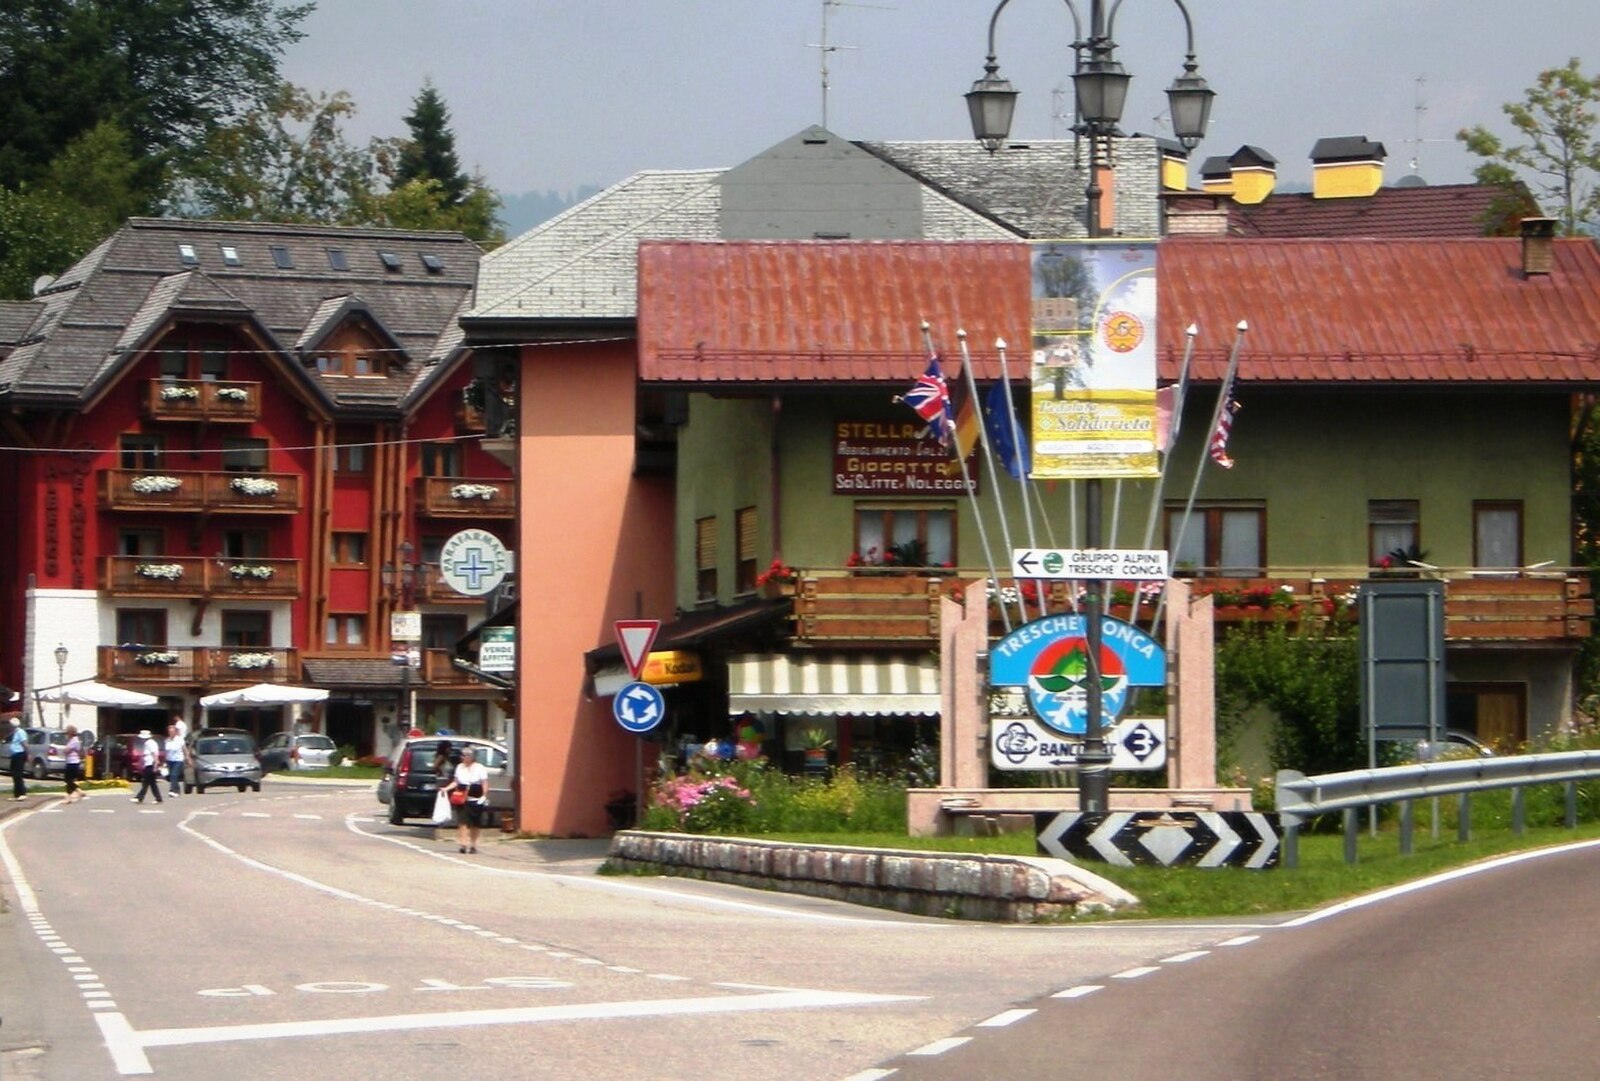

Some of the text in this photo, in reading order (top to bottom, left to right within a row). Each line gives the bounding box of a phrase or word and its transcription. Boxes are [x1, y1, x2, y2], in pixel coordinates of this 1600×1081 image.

[838, 423, 914, 439] STELLA
[443, 532, 505, 572] PARAFARMACIA
[1071, 553, 1160, 563] GRUPPO ALPINI
[1122, 565, 1164, 574] CONCA
[1100, 621, 1156, 659] ONCA
